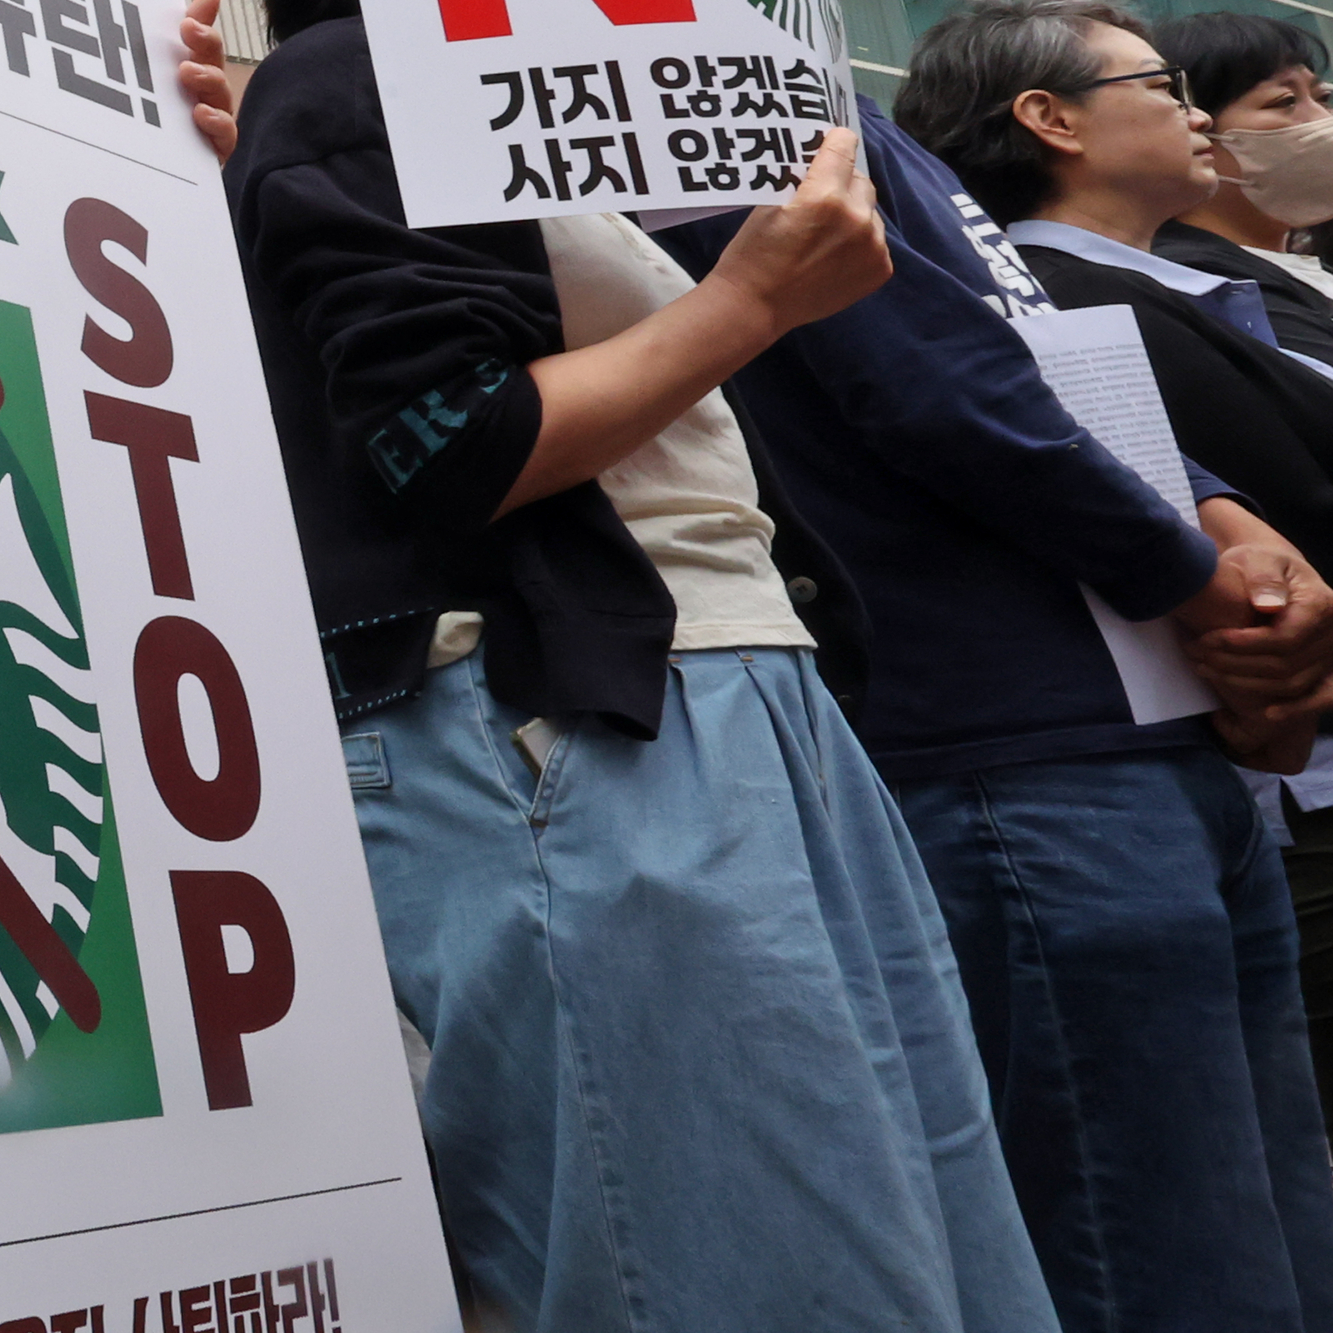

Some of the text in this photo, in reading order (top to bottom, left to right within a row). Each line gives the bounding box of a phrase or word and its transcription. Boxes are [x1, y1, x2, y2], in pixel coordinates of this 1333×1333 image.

[480, 60, 632, 132] 가지
[503, 131, 651, 203] 사지
[63, 196, 296, 1112] STOP
